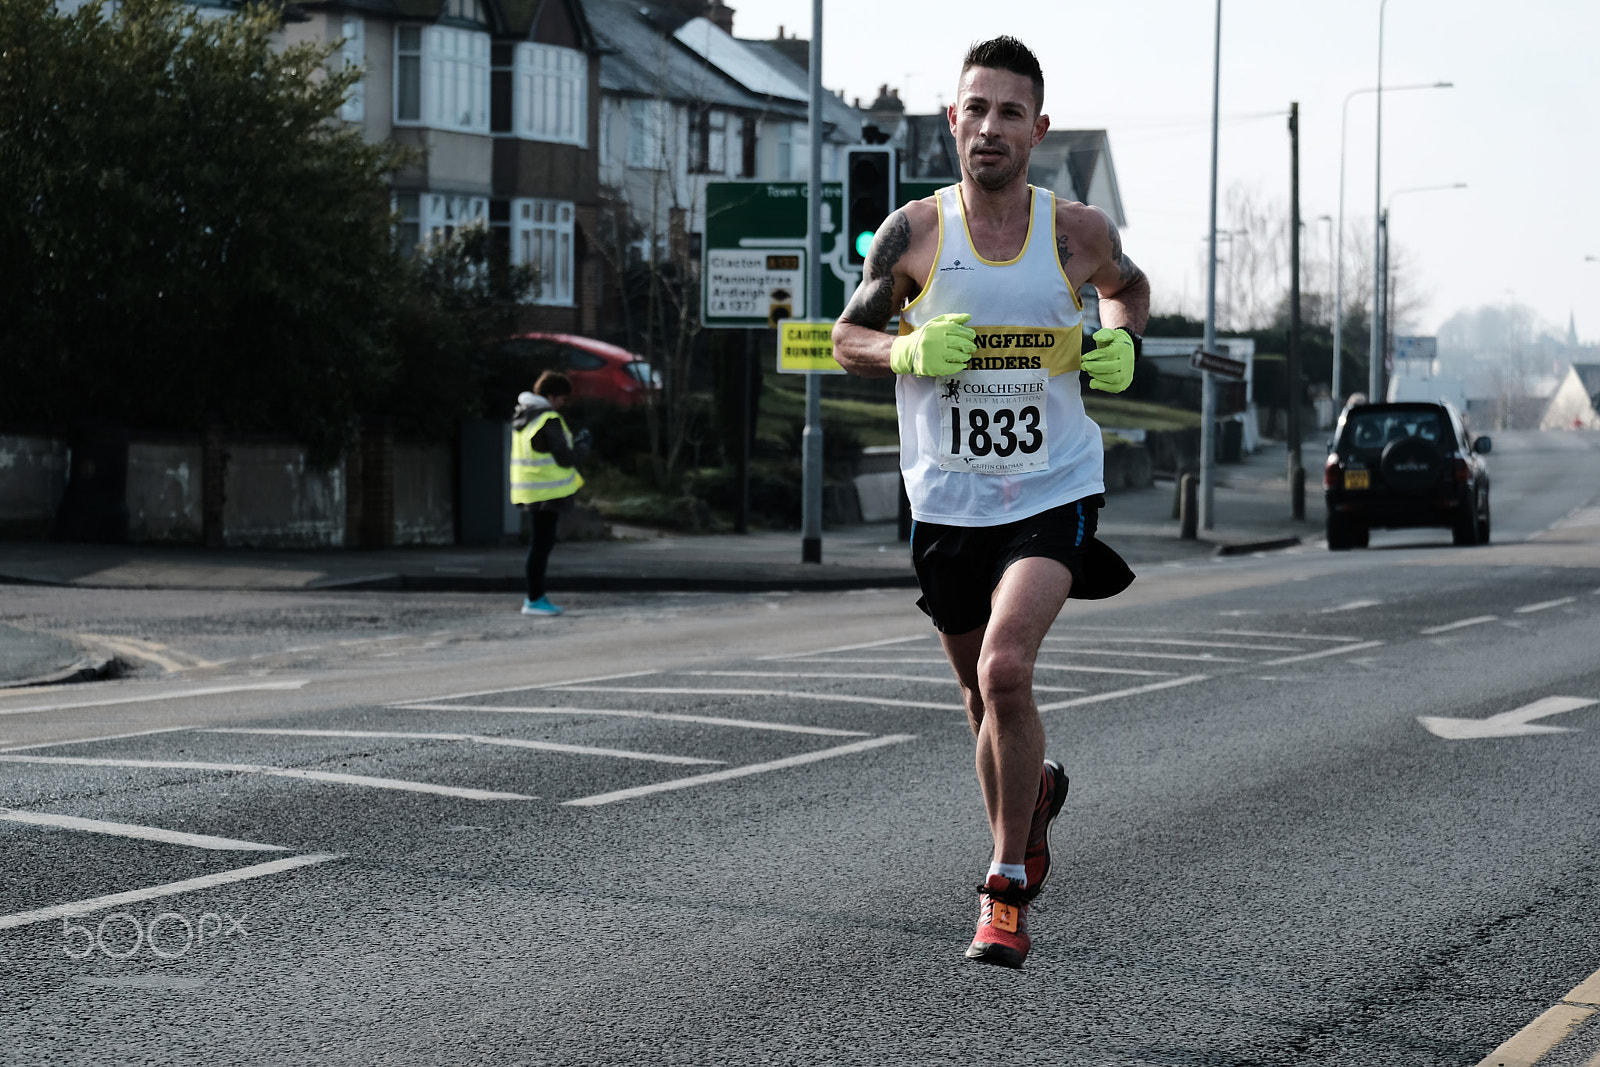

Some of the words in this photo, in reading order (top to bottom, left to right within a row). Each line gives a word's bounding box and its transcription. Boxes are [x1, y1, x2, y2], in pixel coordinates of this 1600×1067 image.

[767, 185, 797, 198] Town
[801, 185, 842, 198] Ctre
[711, 257, 761, 269] Clacton
[713, 275, 791, 287] Manningtree
[713, 288, 765, 300] Ardleigh
[787, 329, 832, 341] CAUTIO
[973, 333, 1055, 349] NGFIELD
[785, 346, 833, 358] RUNNER
[962, 356, 1042, 370] RIDERS
[963, 382, 1044, 394] COLCHESTER
[991, 395, 1042, 405] MARATHON
[951, 405, 1044, 458] 1833
